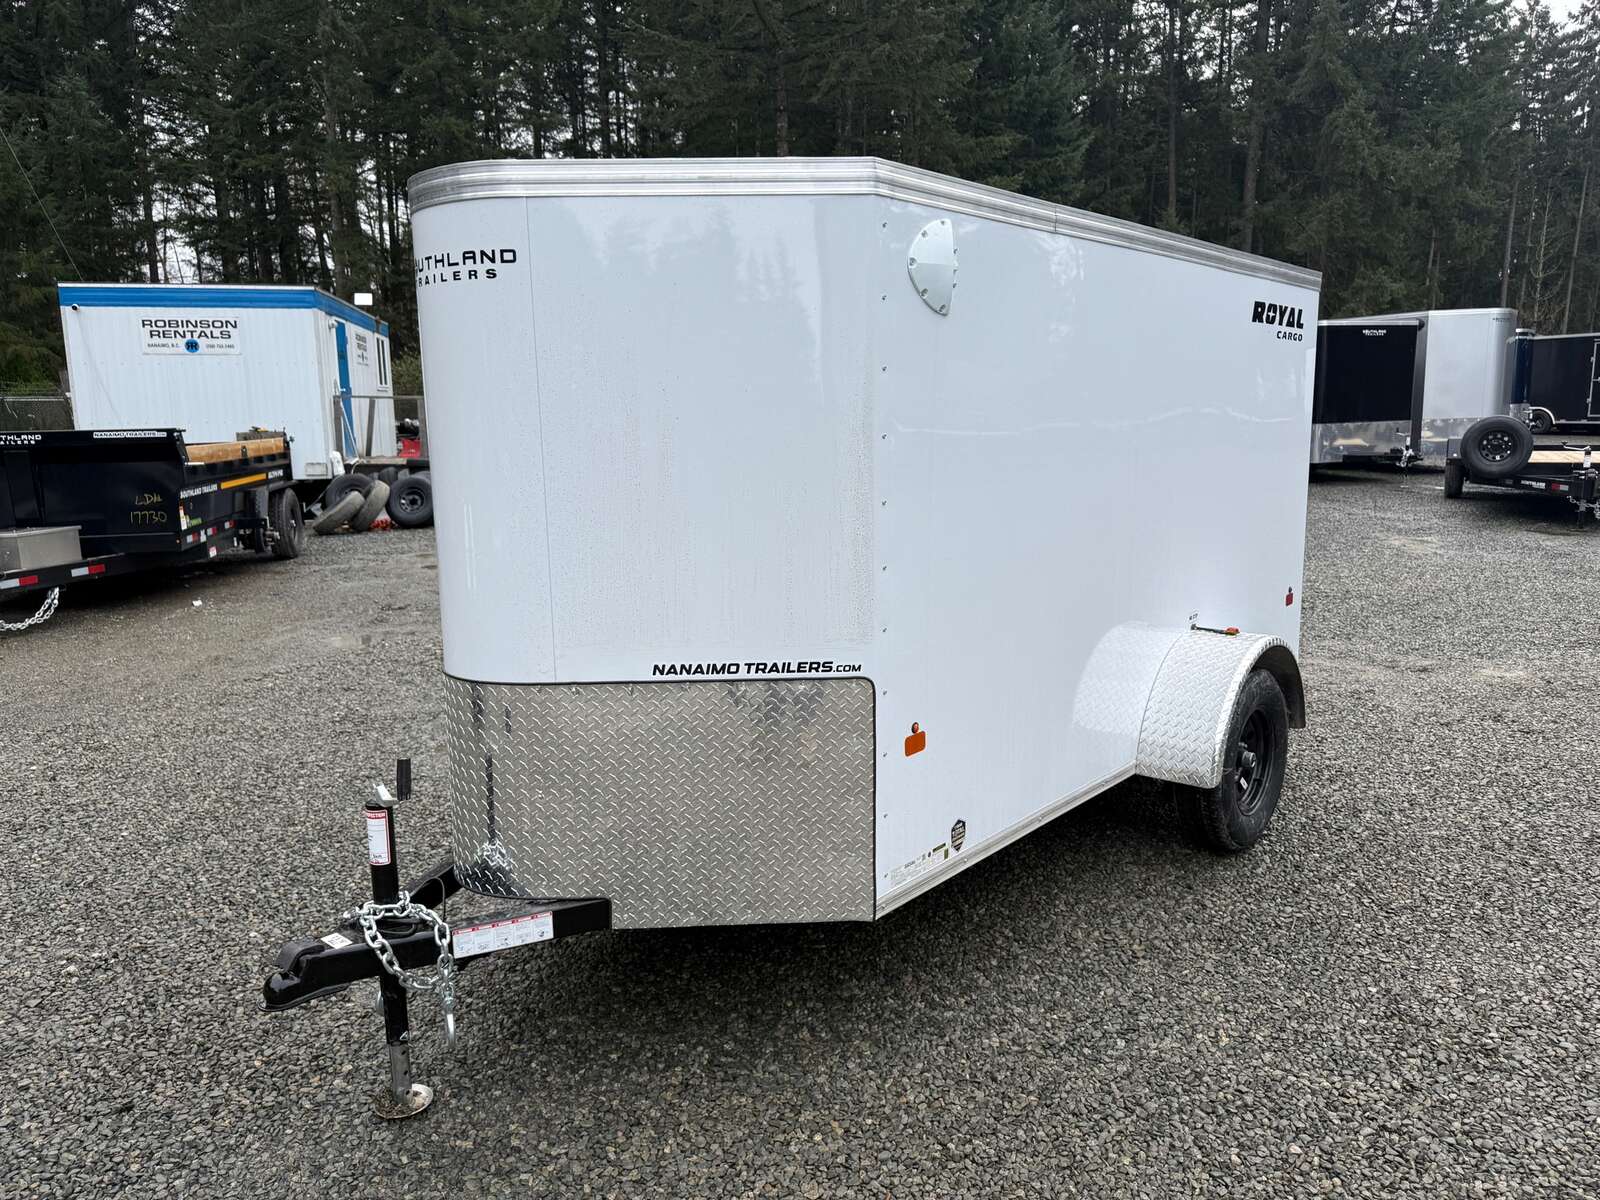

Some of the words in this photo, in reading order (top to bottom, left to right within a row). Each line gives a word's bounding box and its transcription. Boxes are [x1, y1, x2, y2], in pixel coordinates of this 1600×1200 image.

[1252, 301, 1304, 329] ROYAL
[141, 319, 238, 328] ROBINSON
[149, 330, 232, 339] RENTALS
[1276, 331, 1303, 342] CARGO
[130, 511, 168, 524] 17730
[652, 663, 740, 676] NANAIMO
[744, 661, 862, 675] TRAILERS.COM
